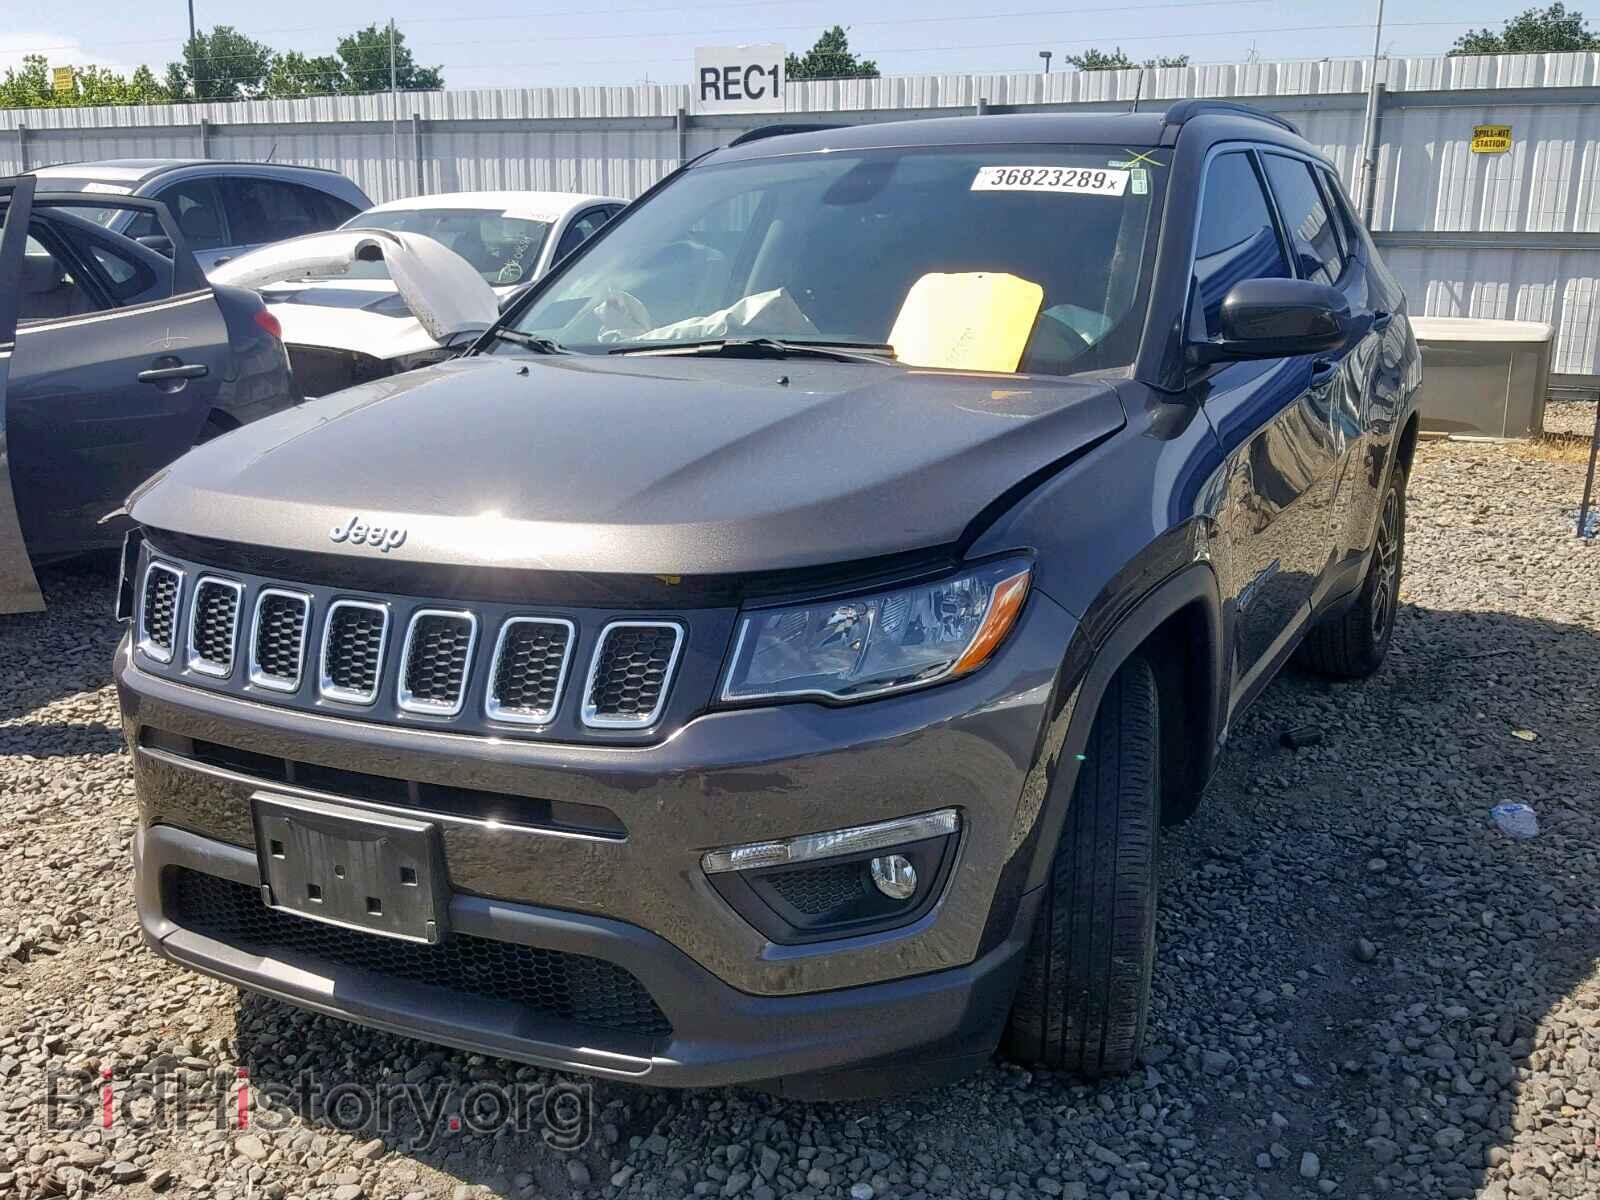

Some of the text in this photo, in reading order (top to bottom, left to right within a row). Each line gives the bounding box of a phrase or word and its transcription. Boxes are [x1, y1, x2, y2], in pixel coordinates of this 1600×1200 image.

[700, 64, 779, 101] REC1
[1474, 139, 1506, 148] STATION
[329, 514, 407, 553] Jeep
